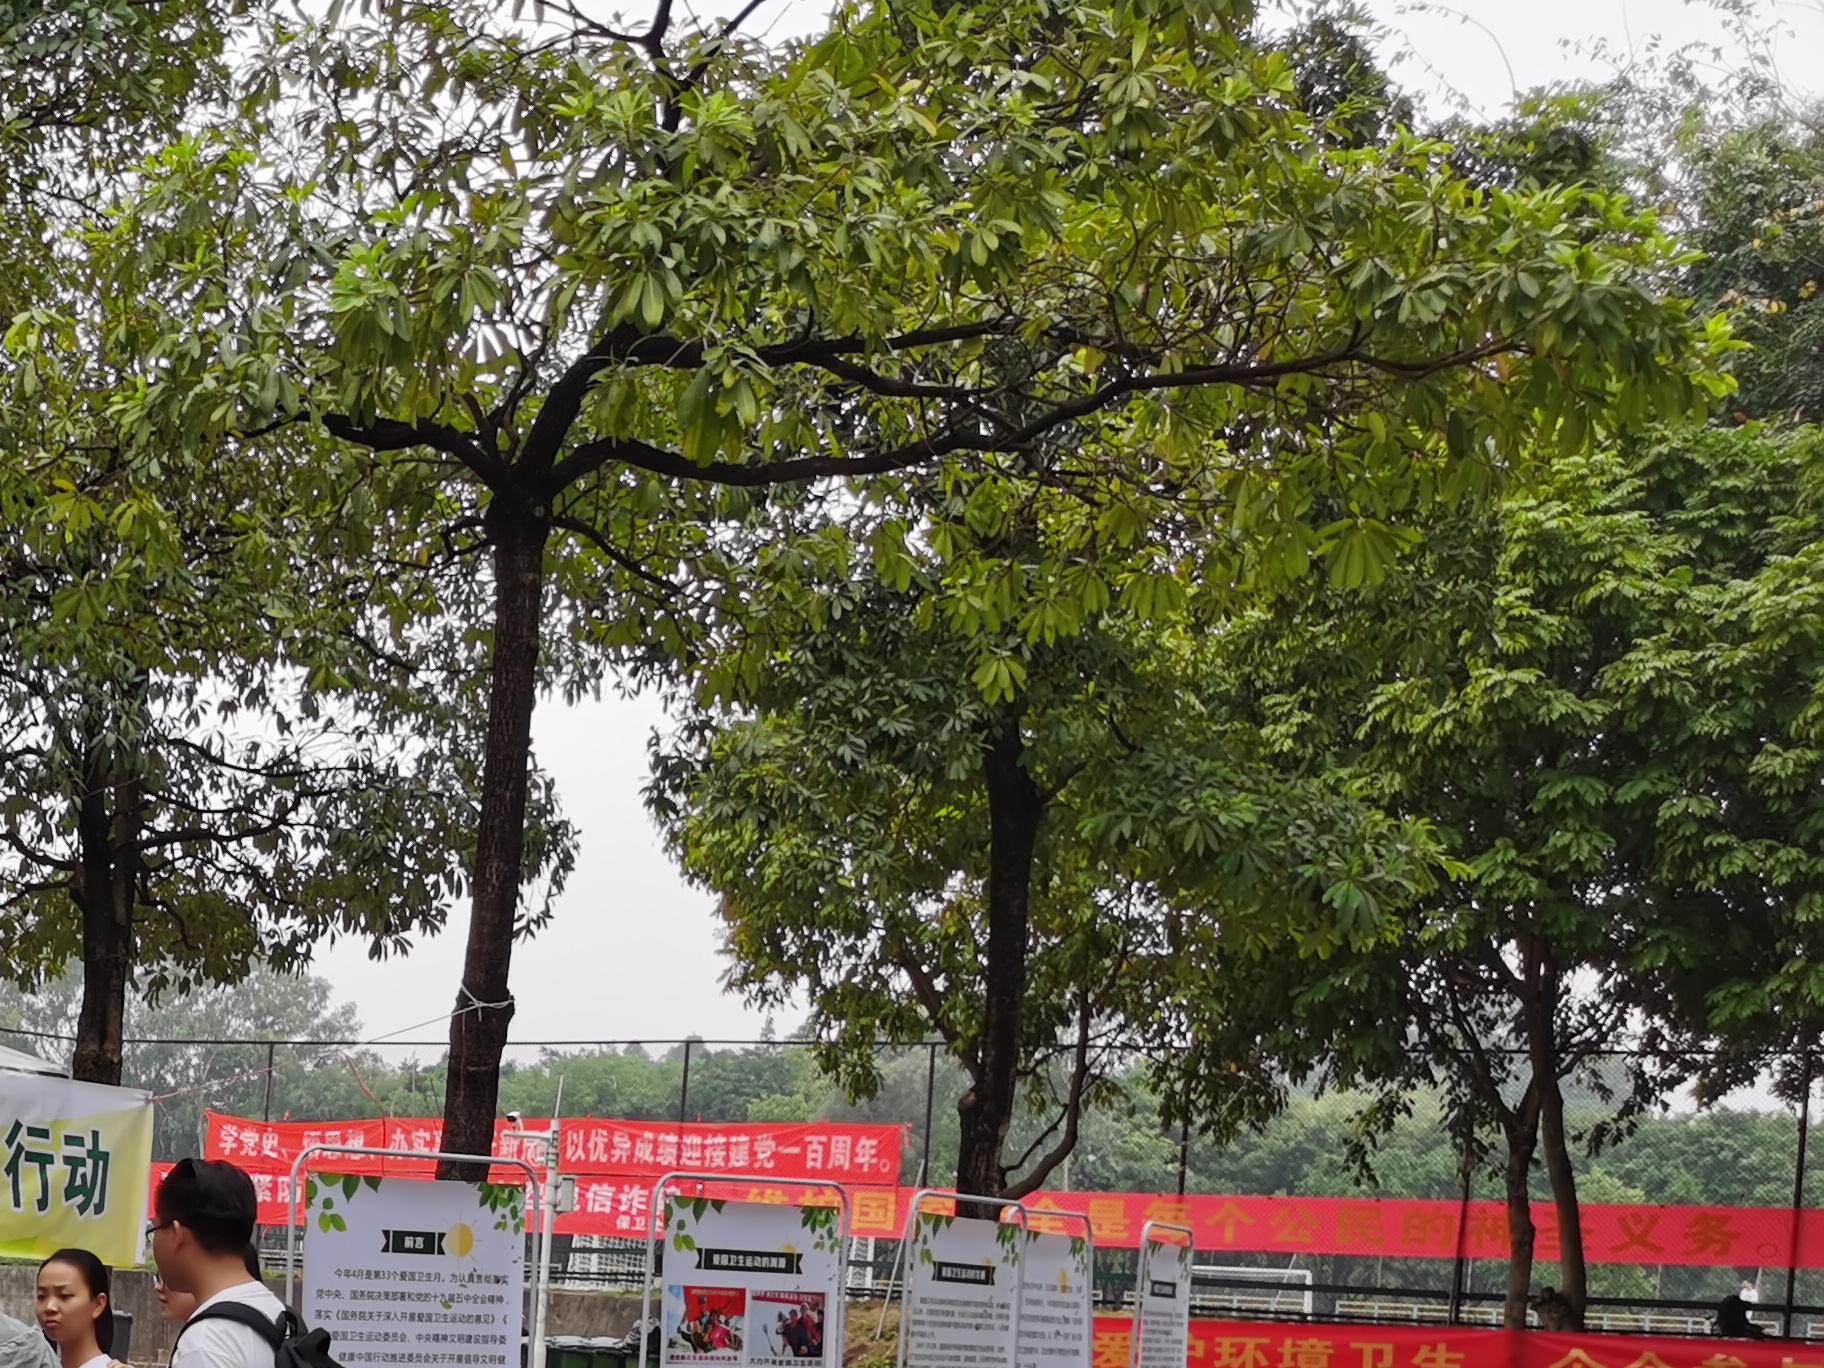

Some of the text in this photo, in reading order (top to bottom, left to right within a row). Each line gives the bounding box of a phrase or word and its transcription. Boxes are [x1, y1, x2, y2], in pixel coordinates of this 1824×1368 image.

[404, 1236, 425, 1249] 前言
[330, 1331, 507, 1346] 爱国卫生运动委员会、中央精神文明建设指导委
